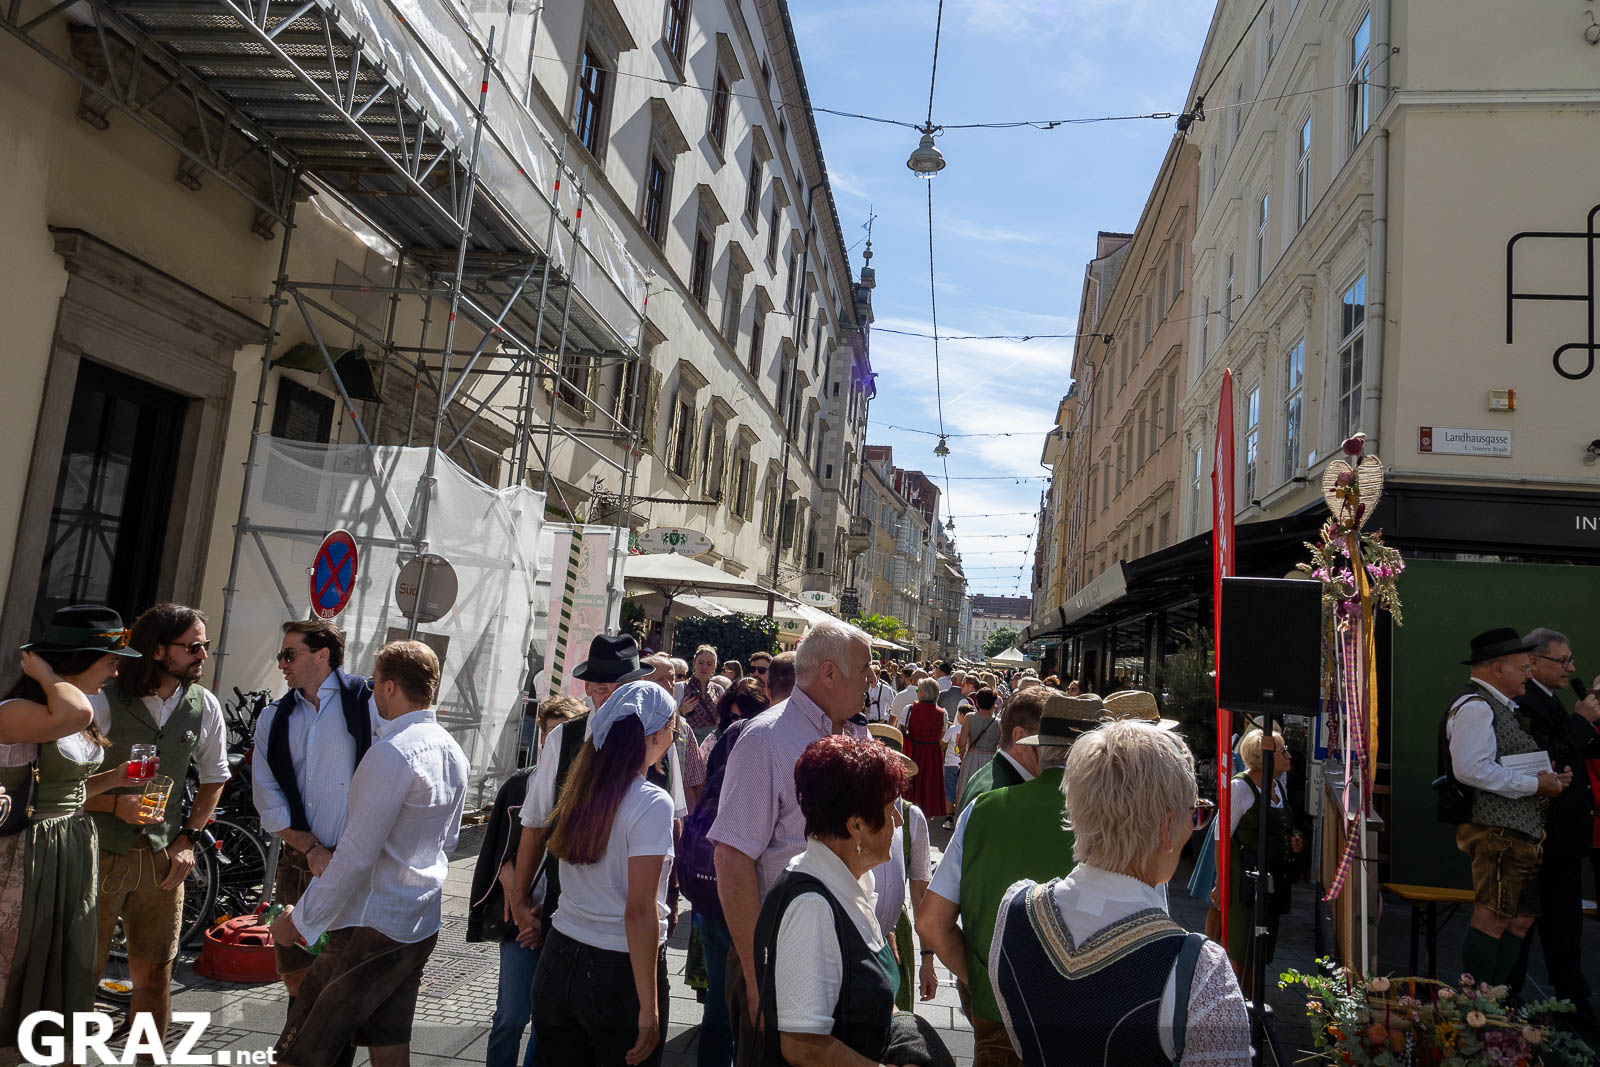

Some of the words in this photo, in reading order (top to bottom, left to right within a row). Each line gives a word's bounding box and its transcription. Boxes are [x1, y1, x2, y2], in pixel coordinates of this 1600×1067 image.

[1445, 432, 1508, 445] Landhausgasse
[1576, 515, 1600, 530] IN
[321, 607, 336, 618] ENDE
